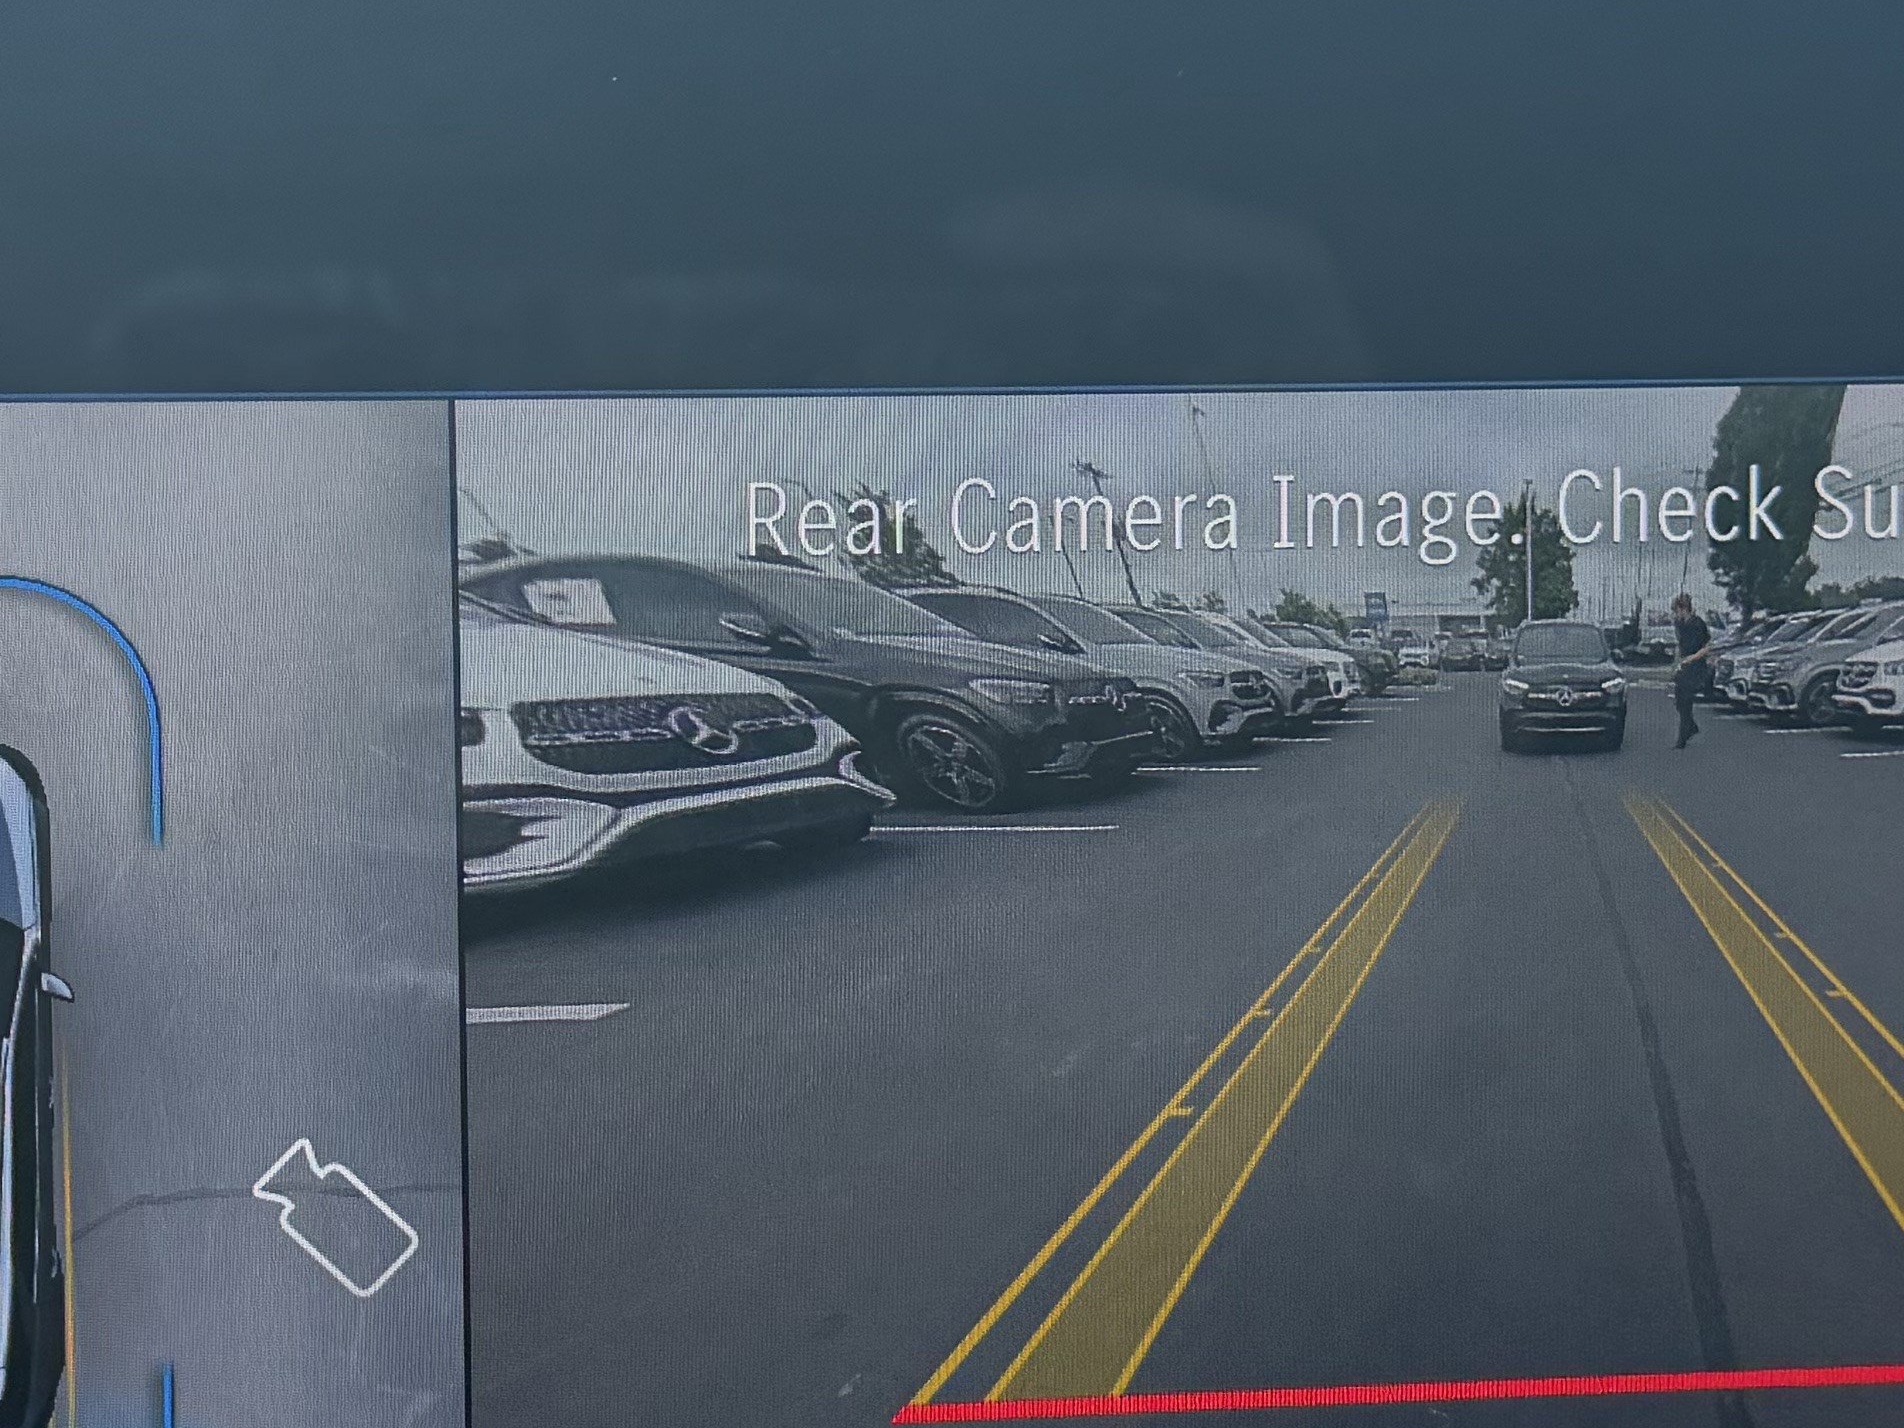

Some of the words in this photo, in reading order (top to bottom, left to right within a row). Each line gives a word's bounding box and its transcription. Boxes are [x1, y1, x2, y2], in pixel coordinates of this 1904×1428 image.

[746, 479, 917, 557] Rear
[951, 477, 1238, 554] Camera
[1271, 474, 1526, 565] Image.
[1558, 465, 1786, 545] Check
